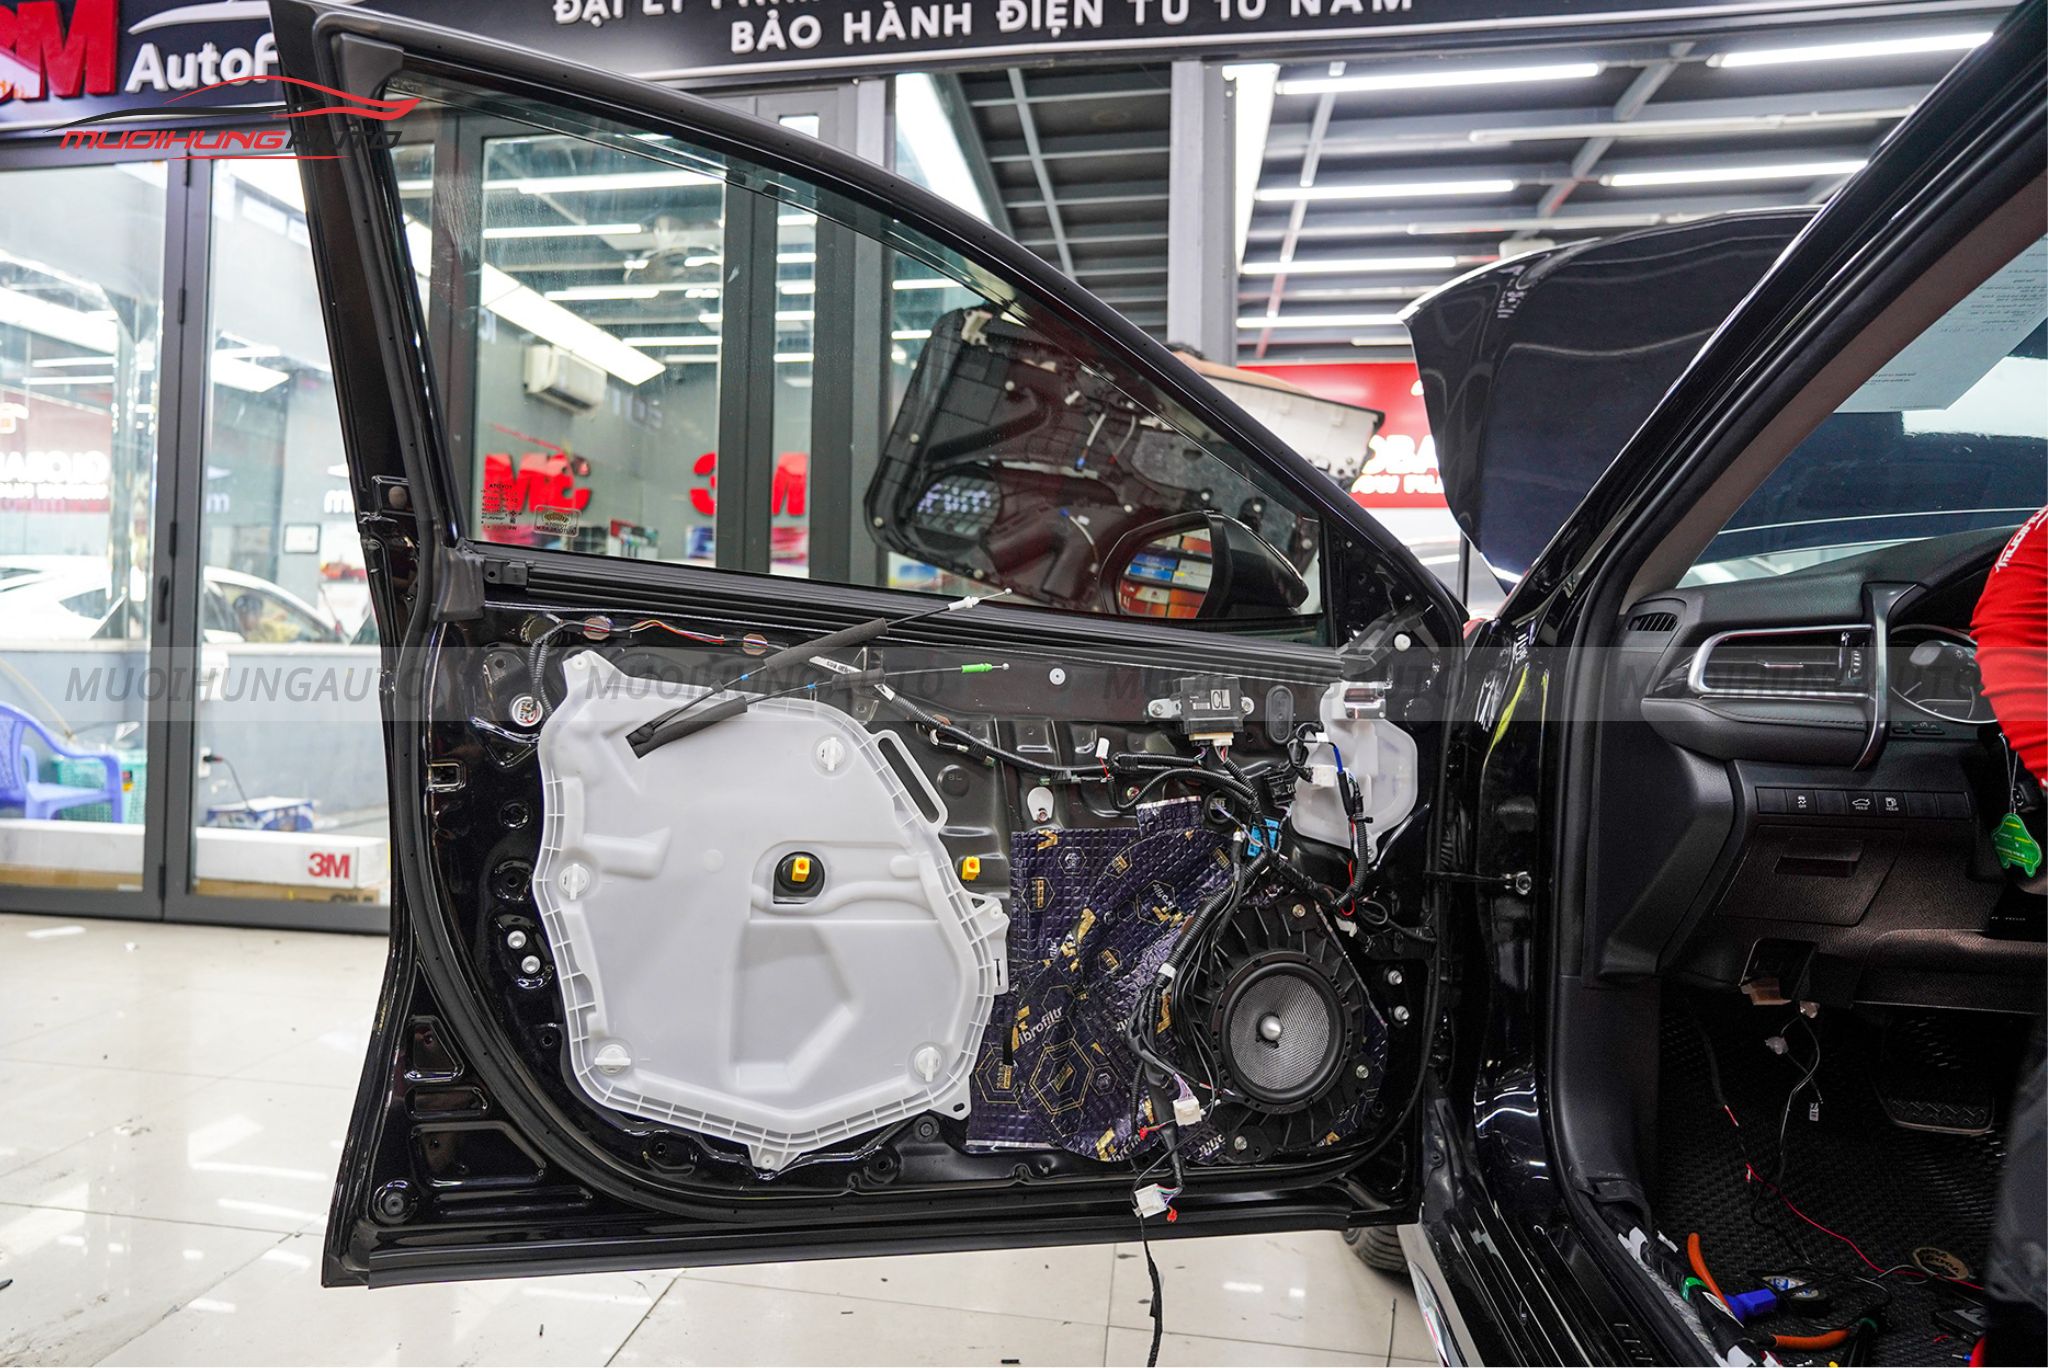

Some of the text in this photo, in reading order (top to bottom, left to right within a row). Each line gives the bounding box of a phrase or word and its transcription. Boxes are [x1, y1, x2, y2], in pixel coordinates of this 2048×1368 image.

[731, 9, 822, 54] BẢO
[843, 1, 972, 45] HÀNH
[124, 33, 279, 93] Autof
[1212, 690, 1229, 709] CL
[308, 852, 350, 880] 3M
